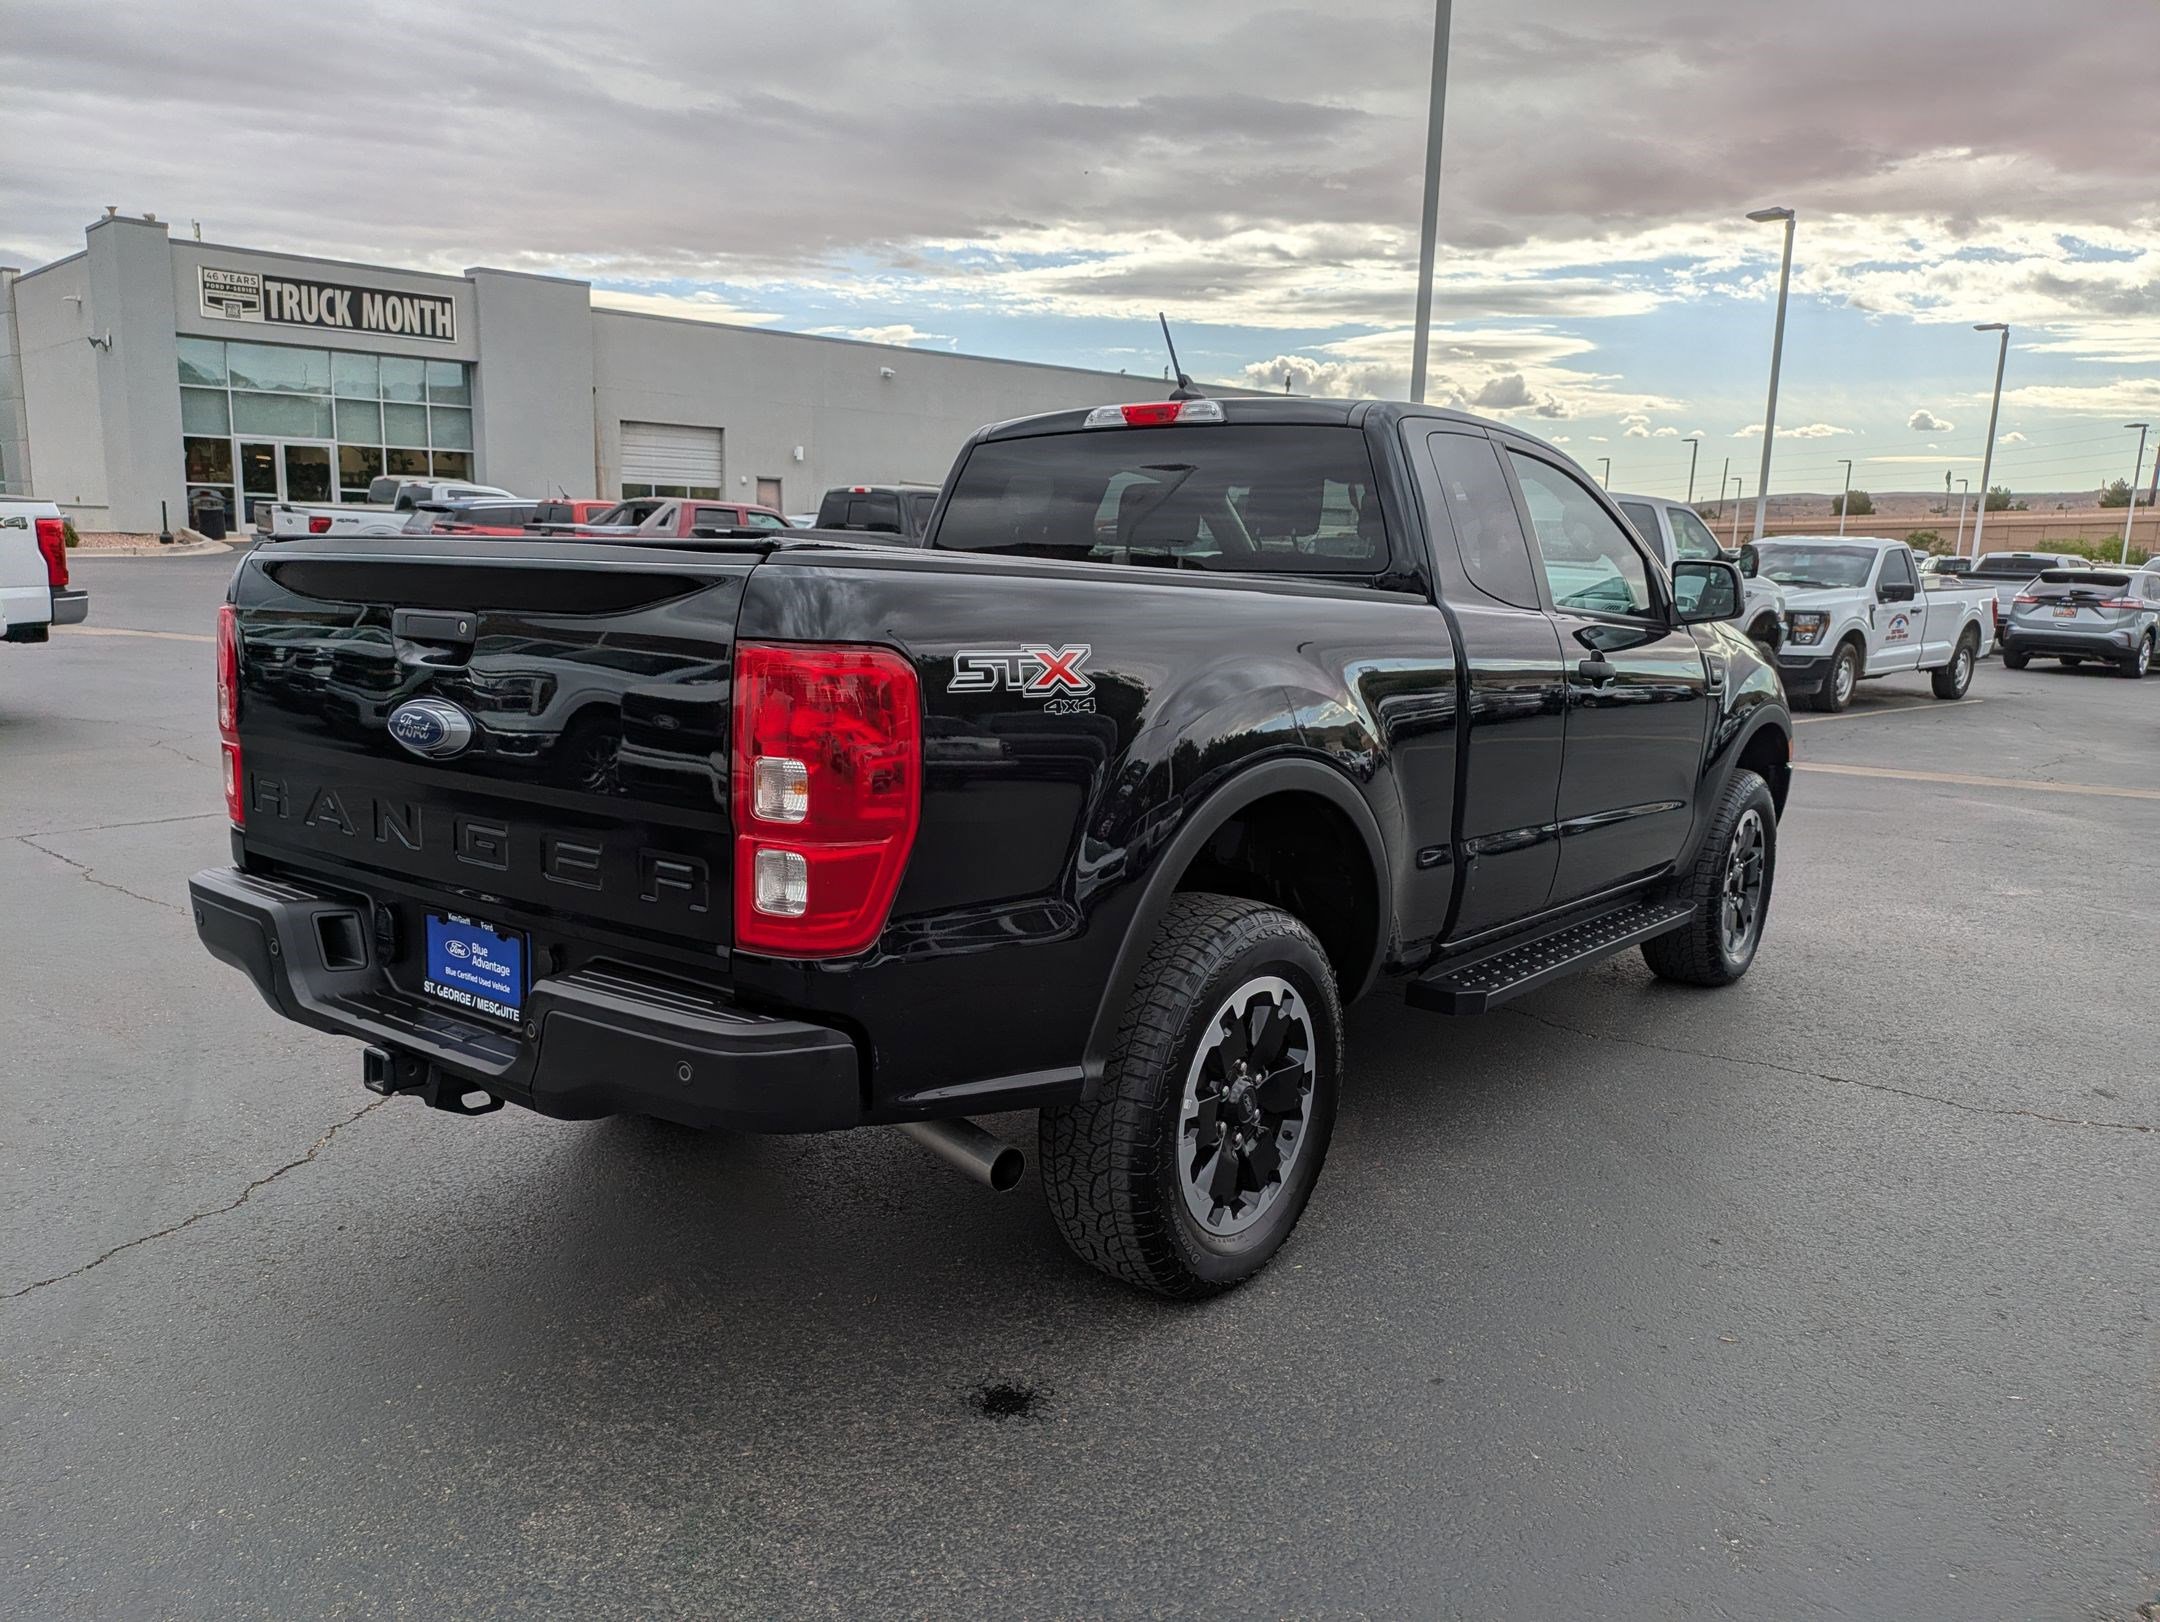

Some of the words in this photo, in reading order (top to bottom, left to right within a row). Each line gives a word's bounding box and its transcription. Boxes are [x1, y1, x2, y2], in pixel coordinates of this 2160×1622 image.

[206, 271, 219, 281] 46
[222, 273, 257, 286] YEARS
[264, 280, 354, 328] TRUCK
[362, 292, 452, 338] MONTH
[946, 643, 1096, 698] STX
[396, 712, 431, 740] Ford
[250, 771, 708, 913] RANGER
[480, 921, 494, 932] Ford
[449, 941, 466, 956] Ford
[472, 942, 489, 957] Blue
[445, 966, 457, 977] Blue
[457, 970, 478, 984] Certified
[478, 976, 491, 988] Used
[491, 980, 511, 994] Vehicle
[471, 955, 511, 977] Advantage
[423, 980, 436, 995] ST.
[436, 984, 471, 1007] GEORGE
[476, 997, 520, 1022] MESQUITE
